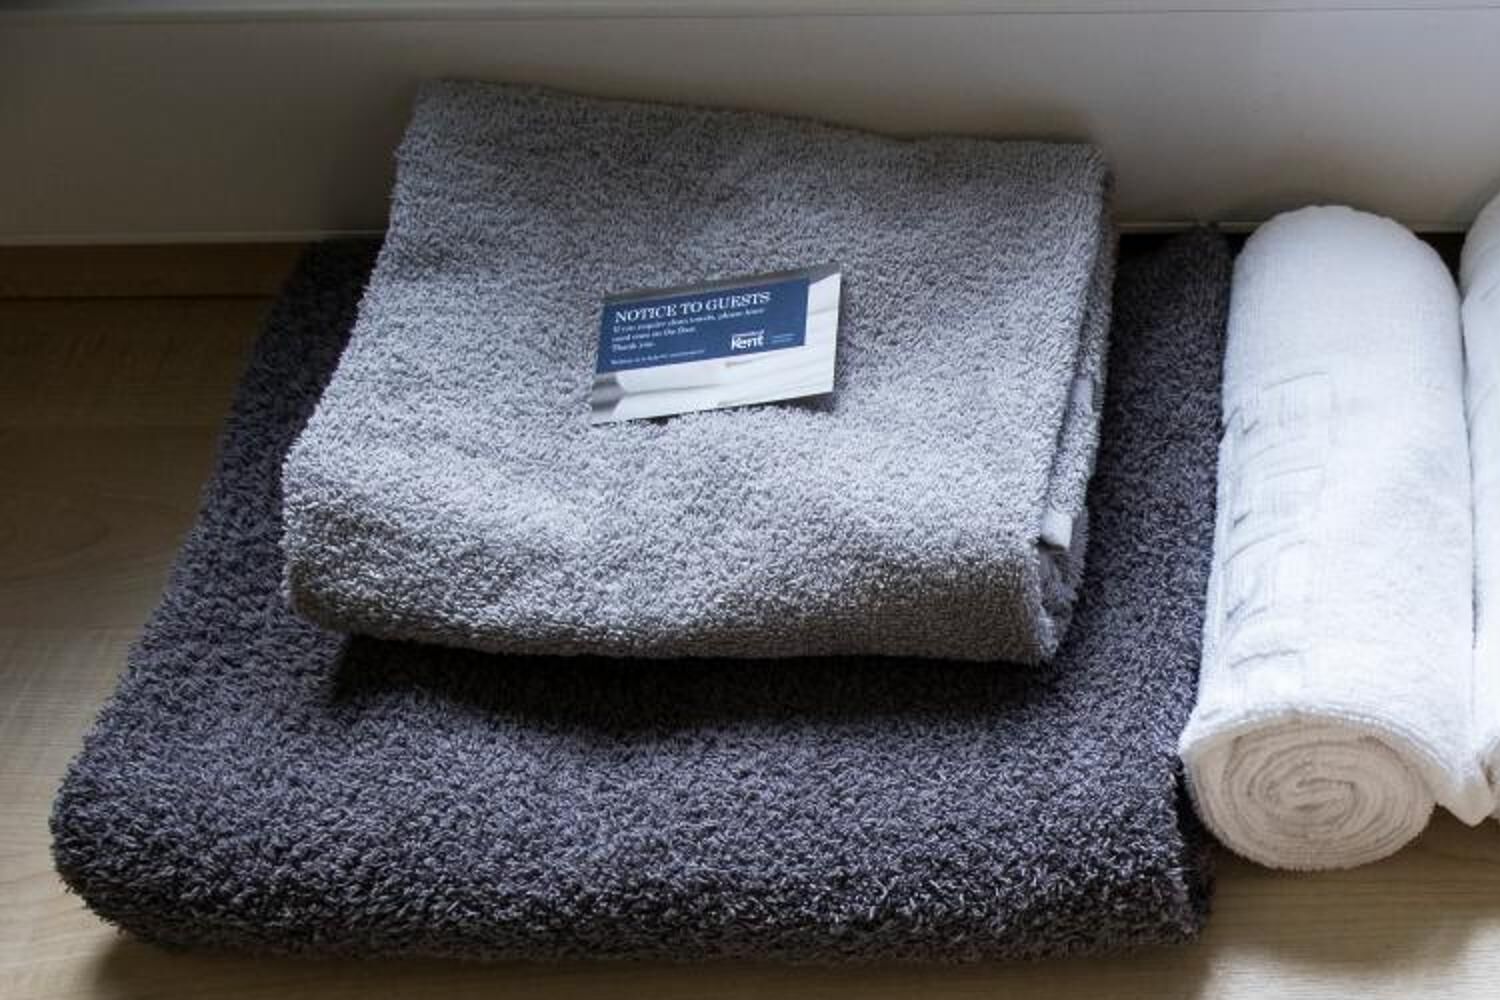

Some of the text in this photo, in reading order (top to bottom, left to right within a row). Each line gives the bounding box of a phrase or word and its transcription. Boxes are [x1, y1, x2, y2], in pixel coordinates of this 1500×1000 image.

[615, 291, 771, 323] NOTICE TO GUESTS
[730, 335, 764, 350] Kent
